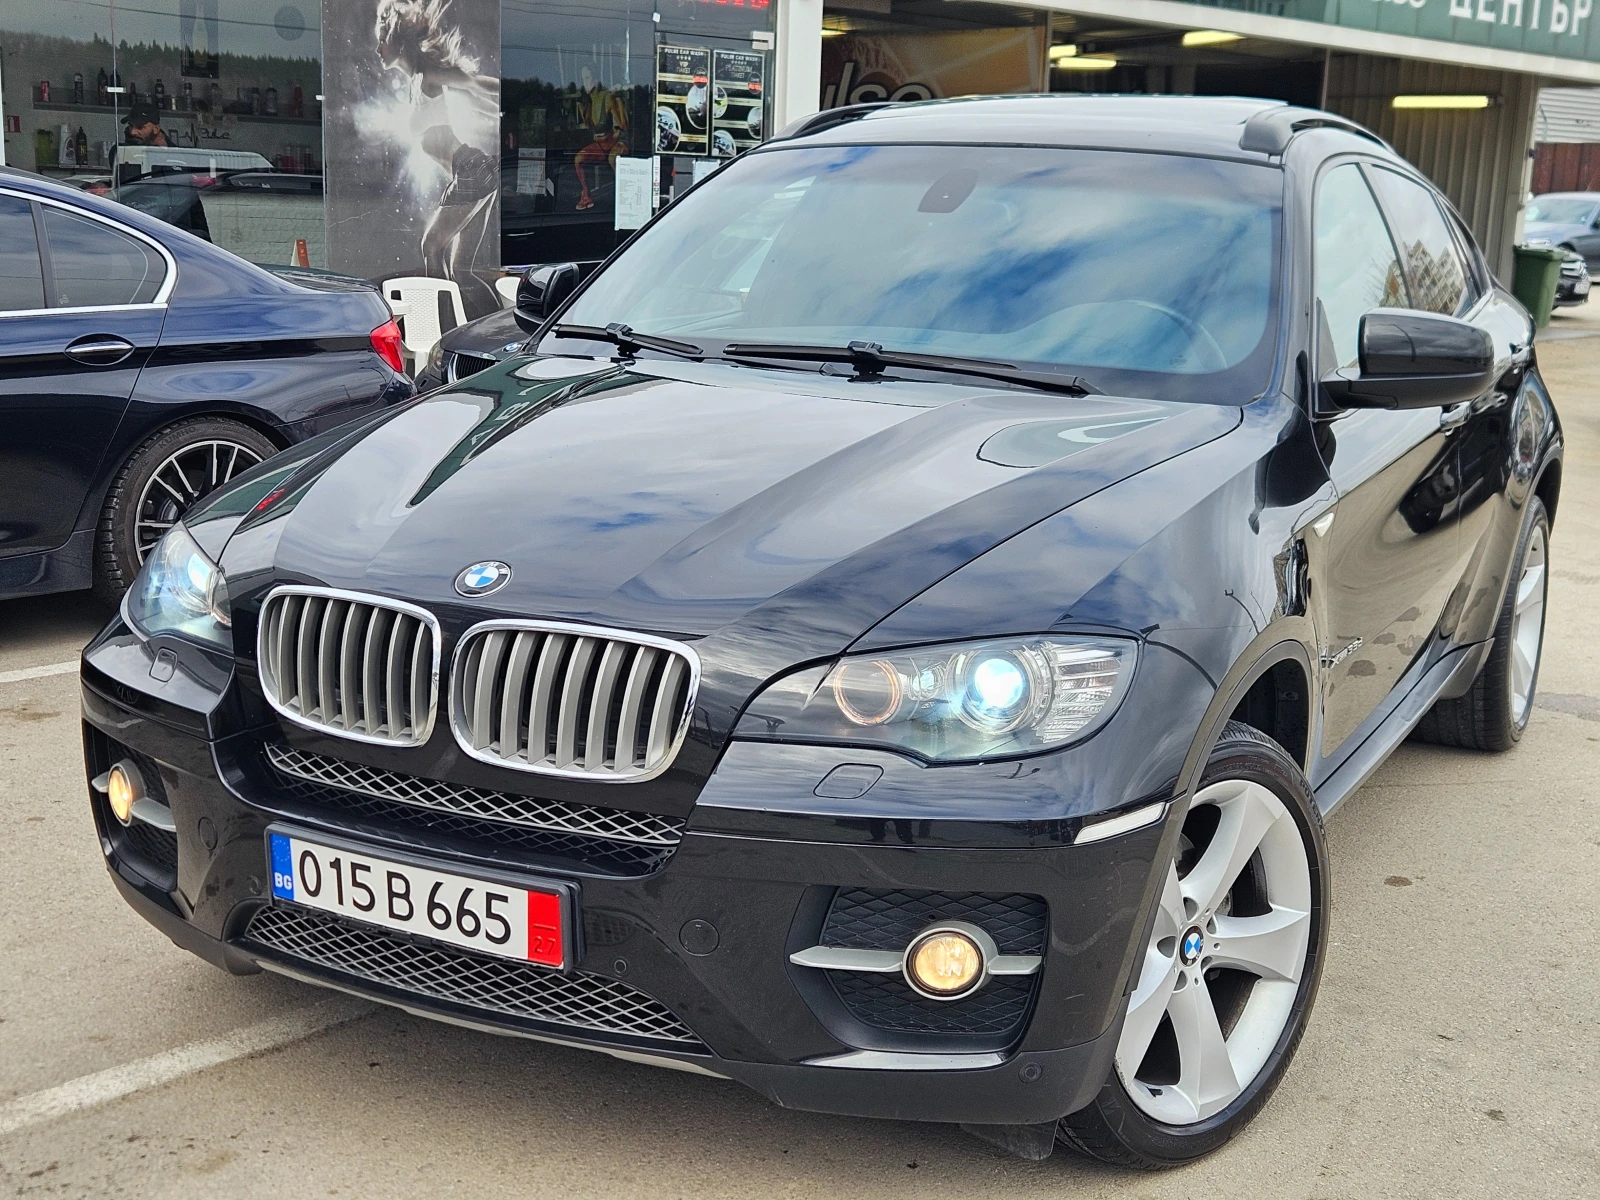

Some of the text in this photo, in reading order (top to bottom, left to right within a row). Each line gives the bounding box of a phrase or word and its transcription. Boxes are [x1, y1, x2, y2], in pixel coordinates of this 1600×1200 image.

[157, 426, 197, 449] KUMHO
[274, 872, 293, 890] BG
[534, 935, 556, 955] 27
